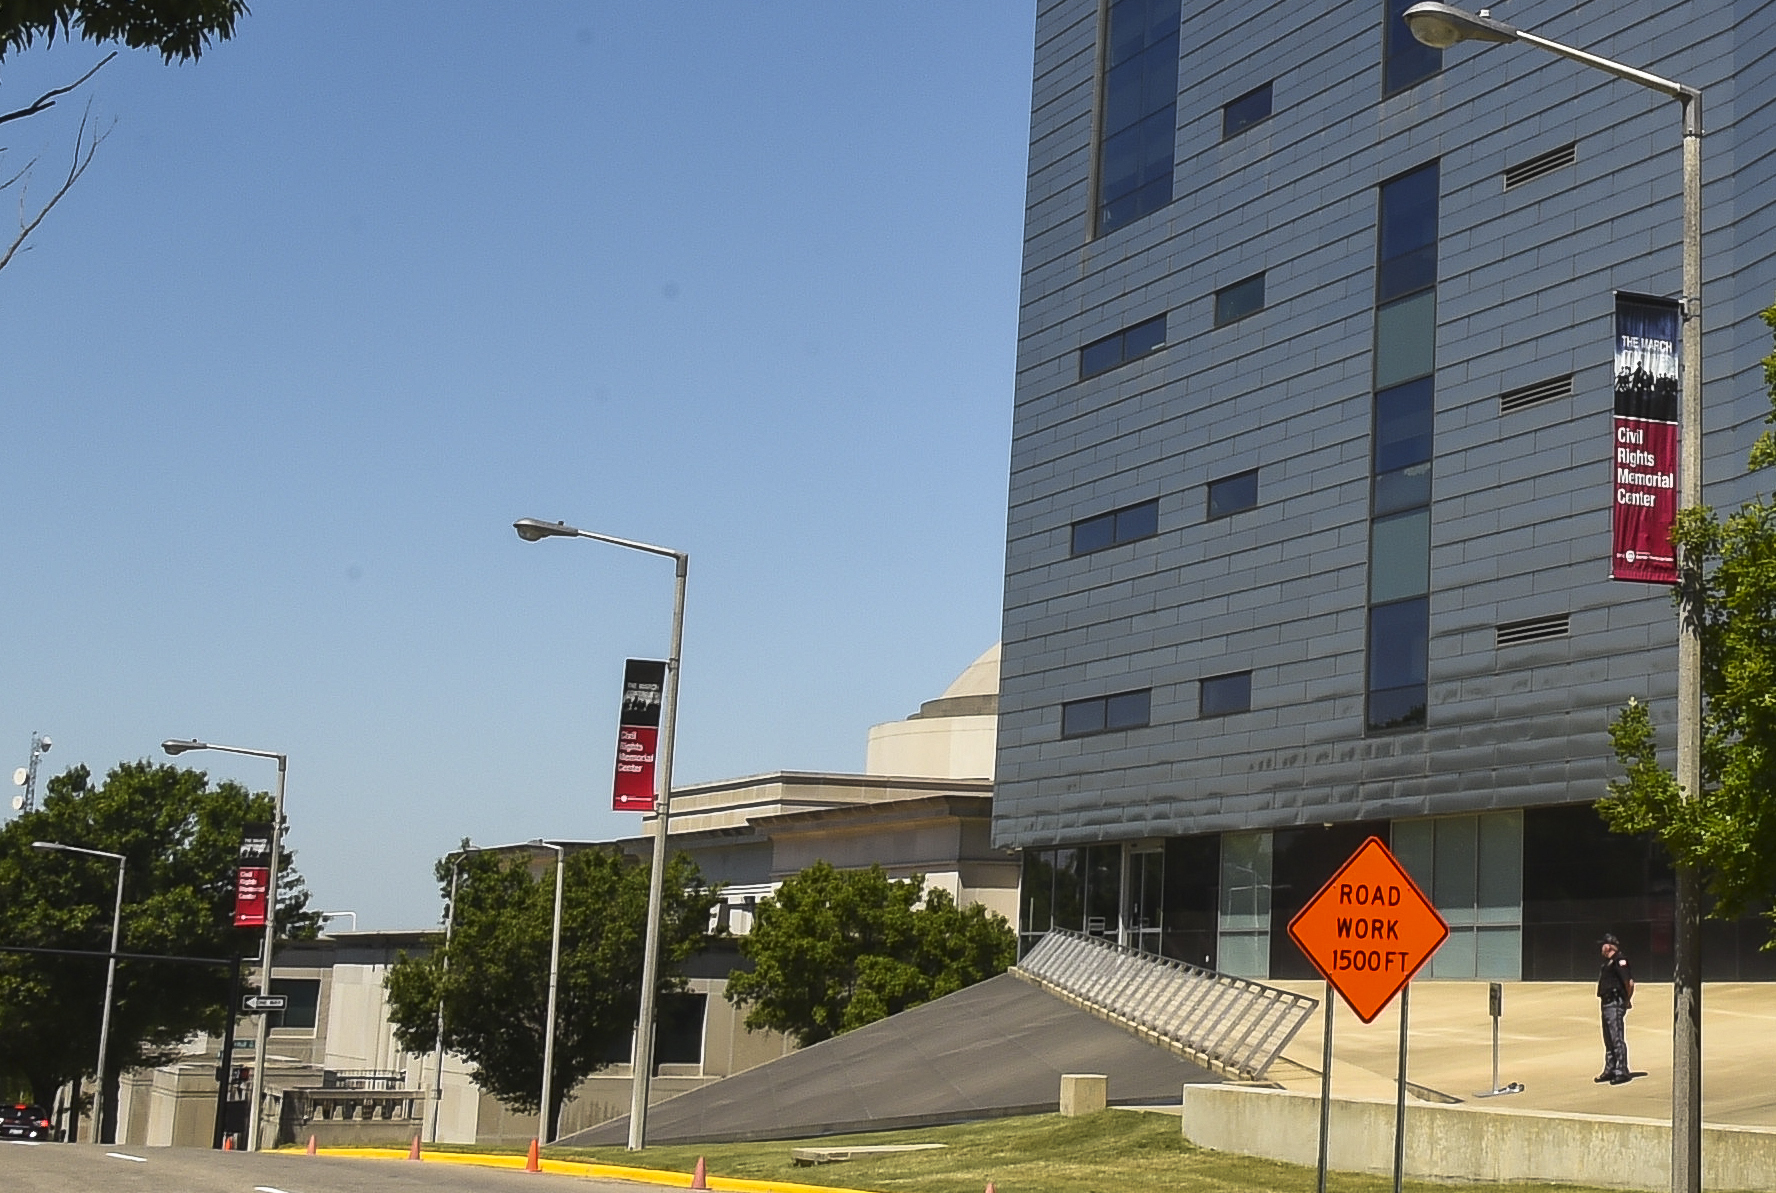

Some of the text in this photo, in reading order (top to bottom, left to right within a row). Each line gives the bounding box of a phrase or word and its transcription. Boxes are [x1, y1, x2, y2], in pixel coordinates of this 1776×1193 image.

[1622, 335, 1672, 354] THE MARCH
[1617, 427, 1643, 444] Civil
[1617, 447, 1655, 468] Rights
[1617, 468, 1674, 488] Memorial
[1617, 488, 1655, 507] Center
[1339, 883, 1401, 906] ROAD
[1337, 917, 1399, 940] WORK
